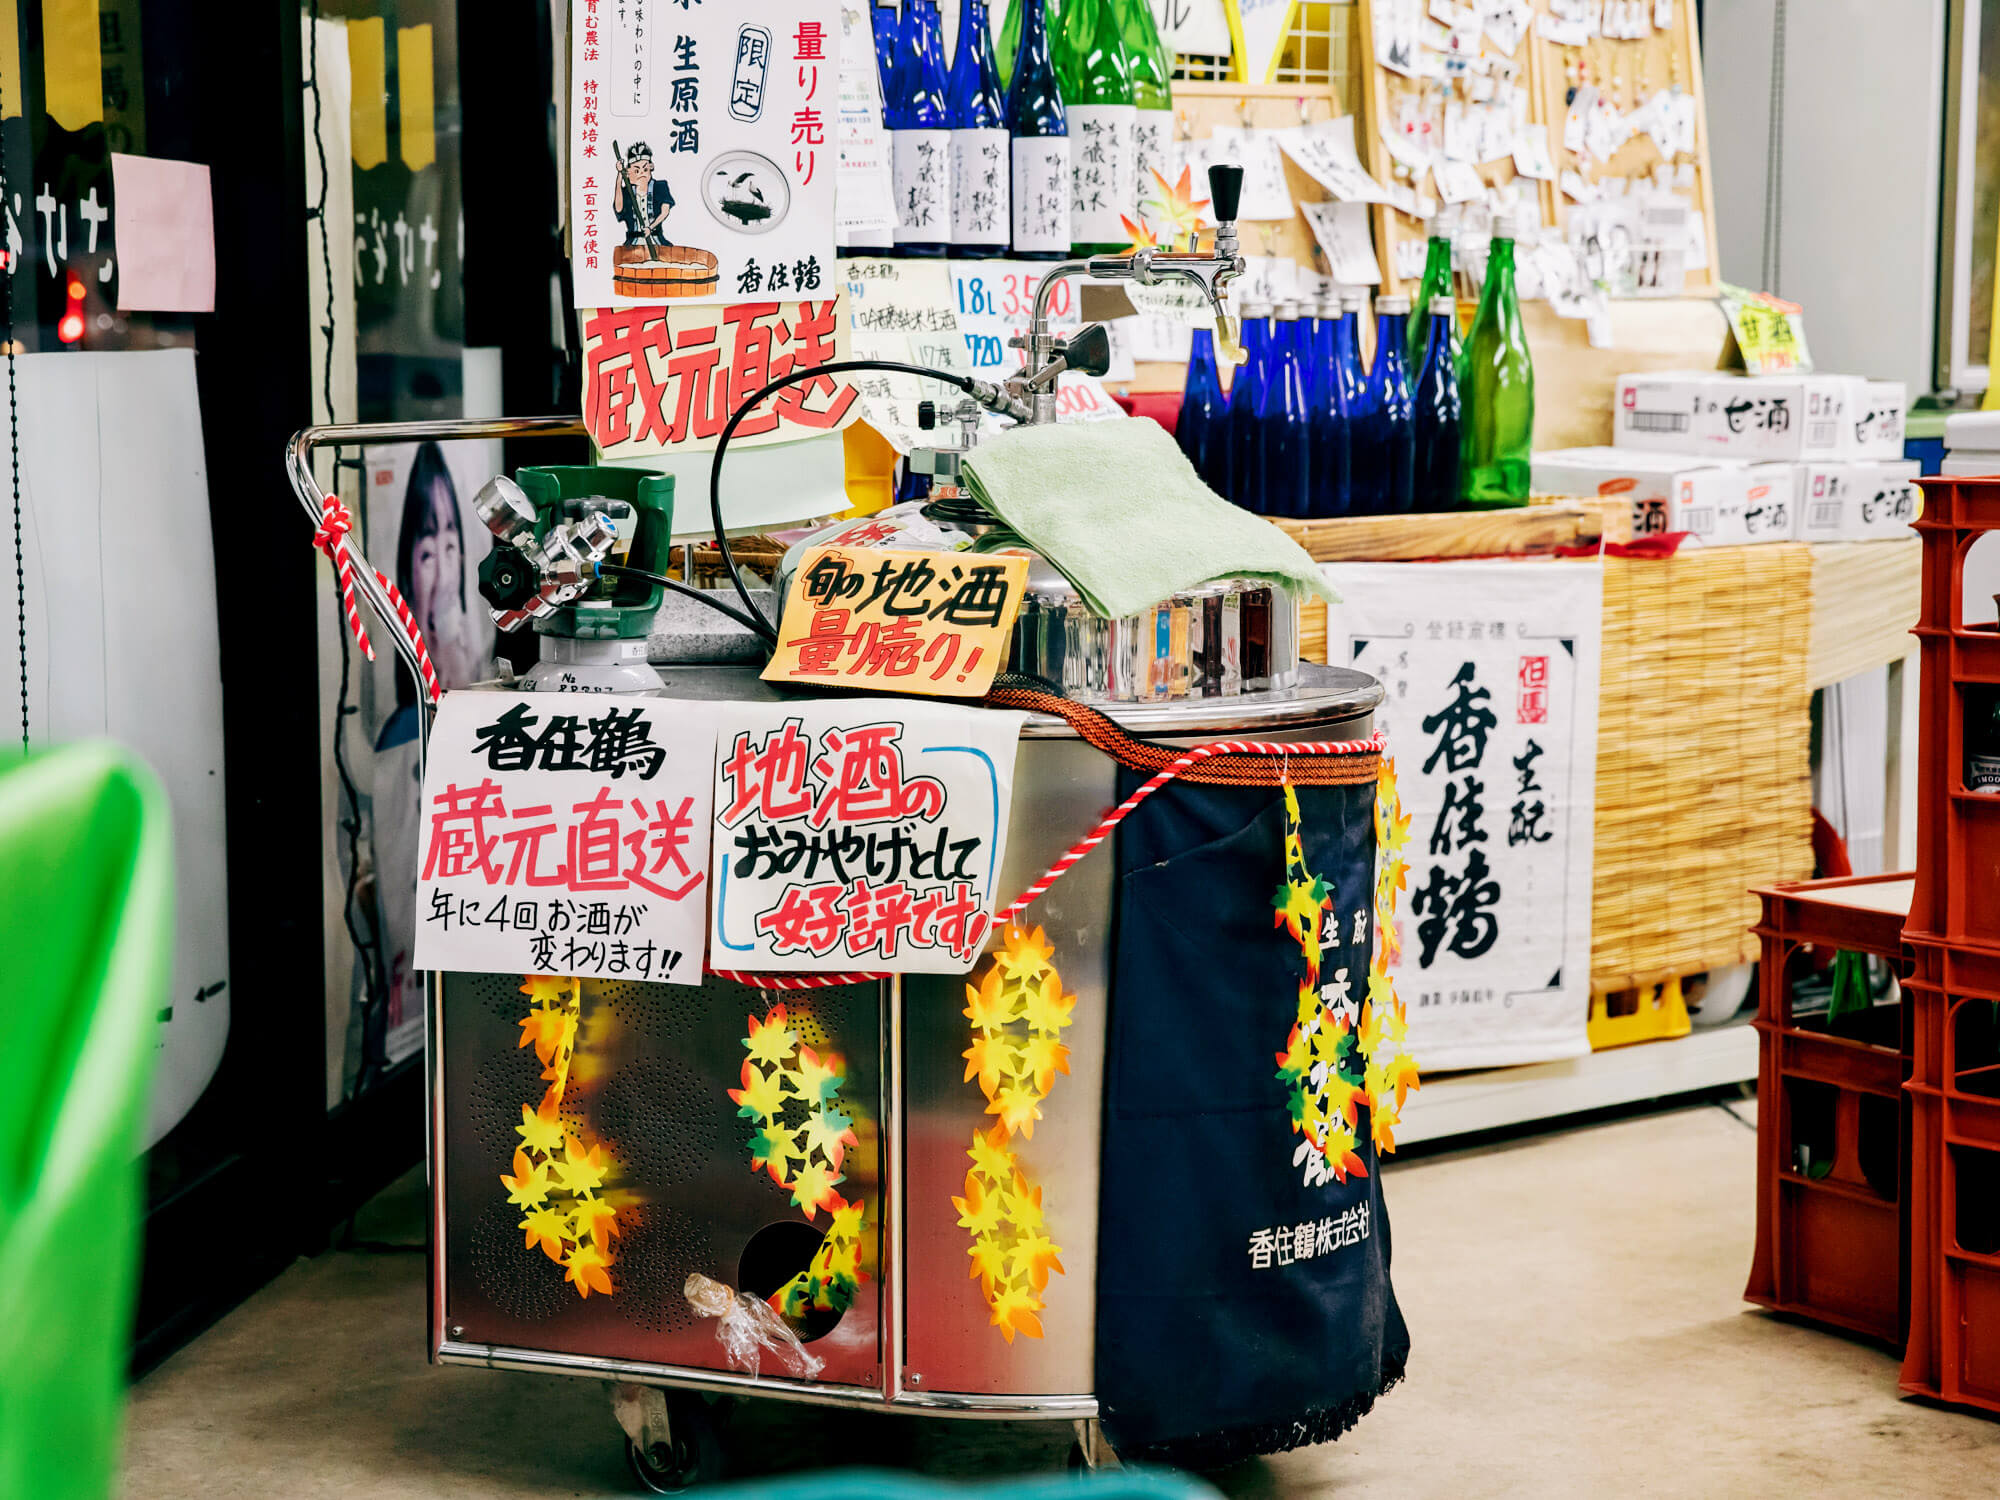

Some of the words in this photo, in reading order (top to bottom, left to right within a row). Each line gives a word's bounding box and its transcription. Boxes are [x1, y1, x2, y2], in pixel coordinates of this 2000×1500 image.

[633, 0, 645, 105] 味わいの中に
[731, 34, 765, 111] 限定
[582, 79, 600, 159] 特別栽培米
[669, 34, 701, 155] 生原酒
[790, 21, 828, 187] 量り売り
[582, 176, 600, 270] 五百万石使用
[737, 254, 821, 295] 香住鶴
[1002, 274, 1070, 317] 350
[585, 302, 861, 450] 蔵元直送
[964, 333, 1003, 367] 720
[802, 550, 1010, 628] 旬の地酒
[787, 608, 985, 683] 量り売り!
[471, 702, 668, 780] 香住鶴
[715, 717, 948, 832] 地酒の
[421, 778, 704, 902] 蔵元直送
[734, 822, 981, 884] おみやげとして
[1411, 661, 1501, 969] 香住鶴
[757, 876, 993, 964] 好評です!
[1248, 1200, 1371, 1270] 香住鶴株式会社
